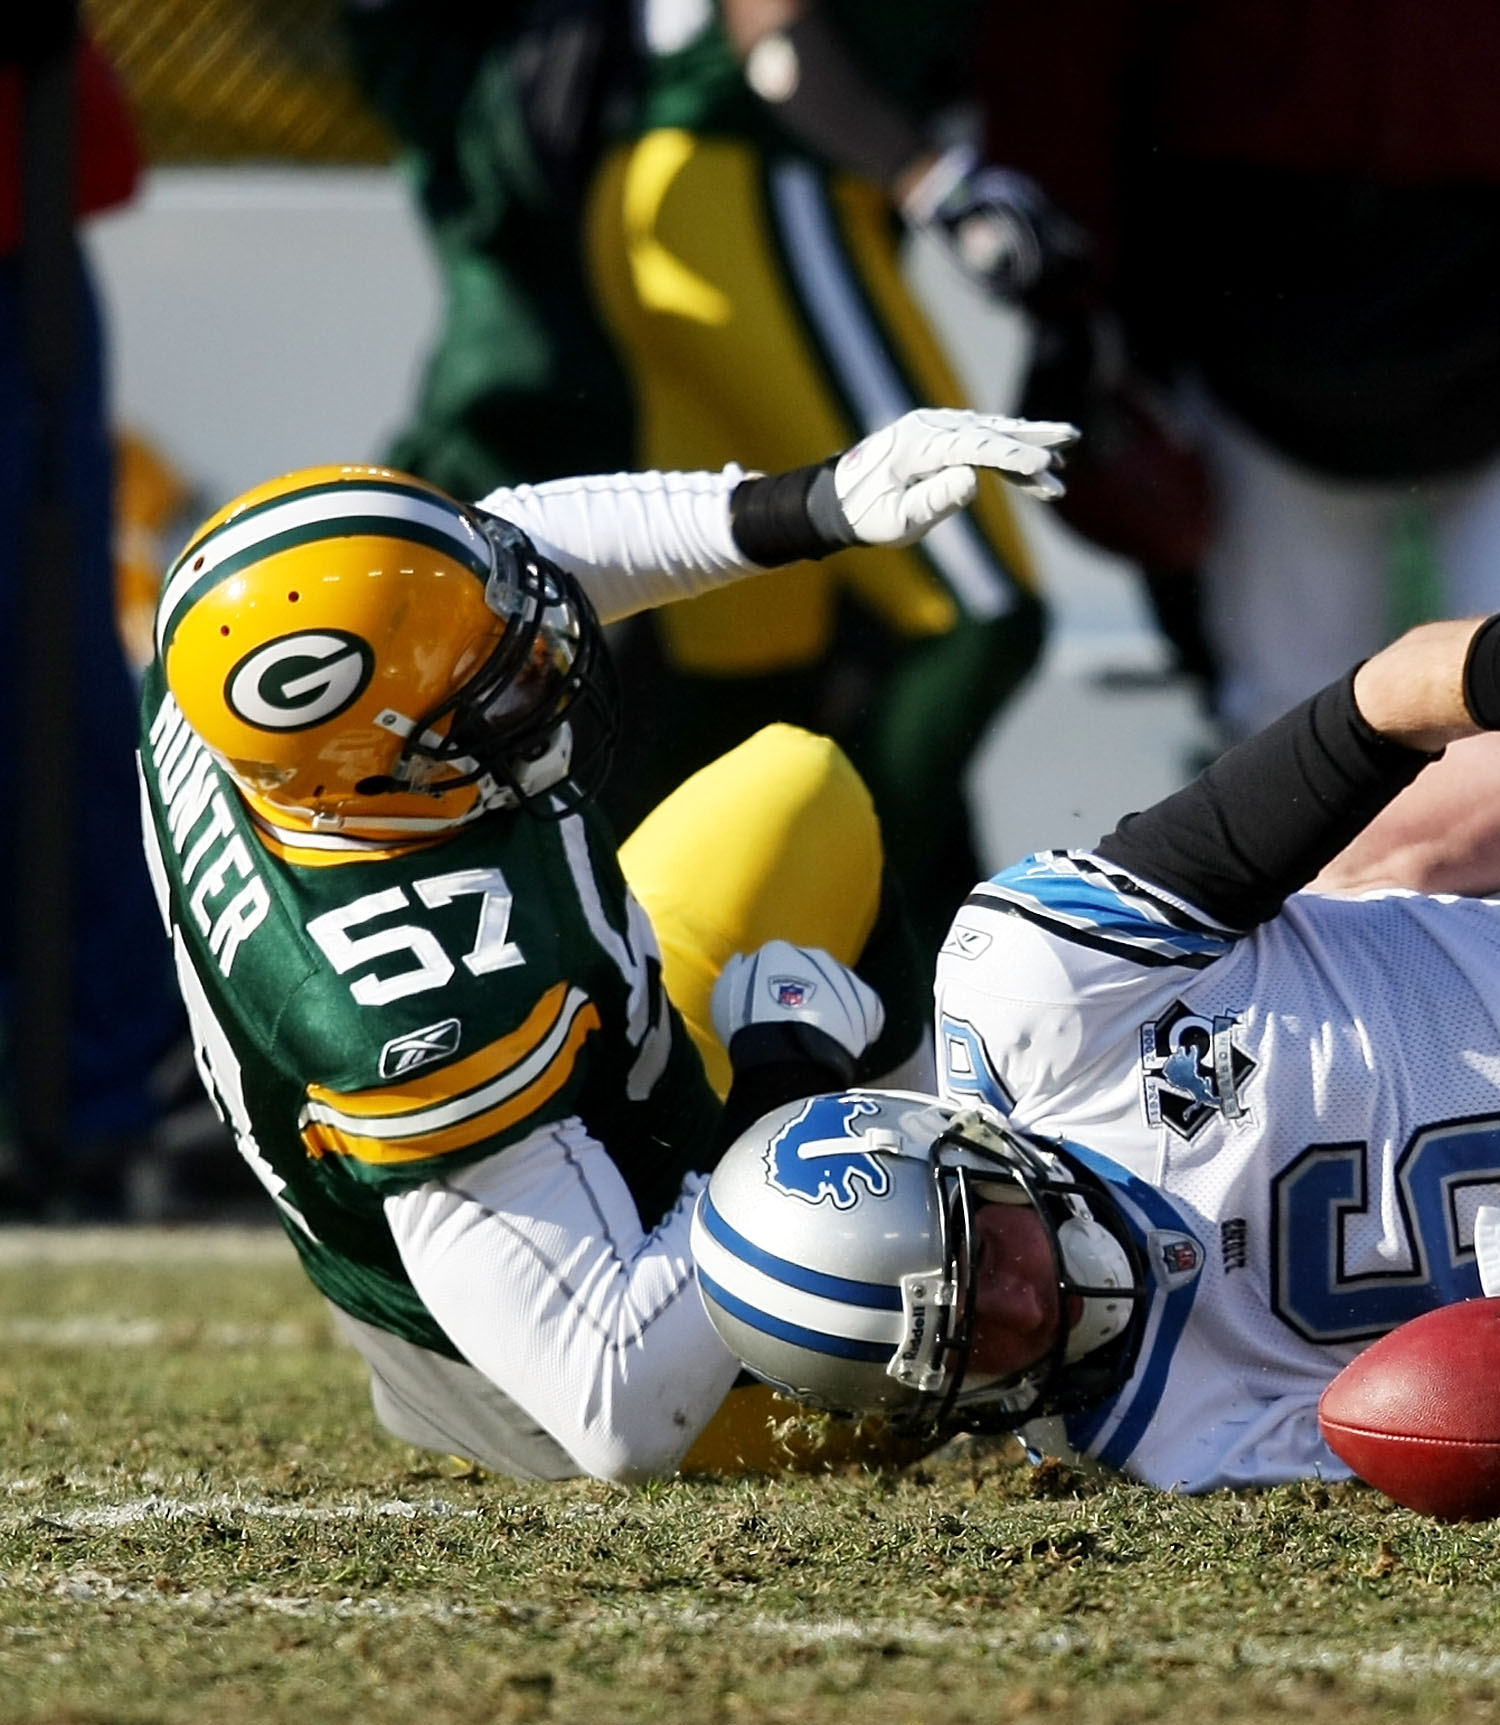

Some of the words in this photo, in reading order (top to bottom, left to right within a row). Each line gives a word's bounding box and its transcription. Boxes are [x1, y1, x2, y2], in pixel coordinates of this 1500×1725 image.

[230, 634, 364, 727] G
[149, 690, 271, 979] HUNTER
[305, 867, 527, 1007] 57
[902, 1304, 926, 1361] Riddell
